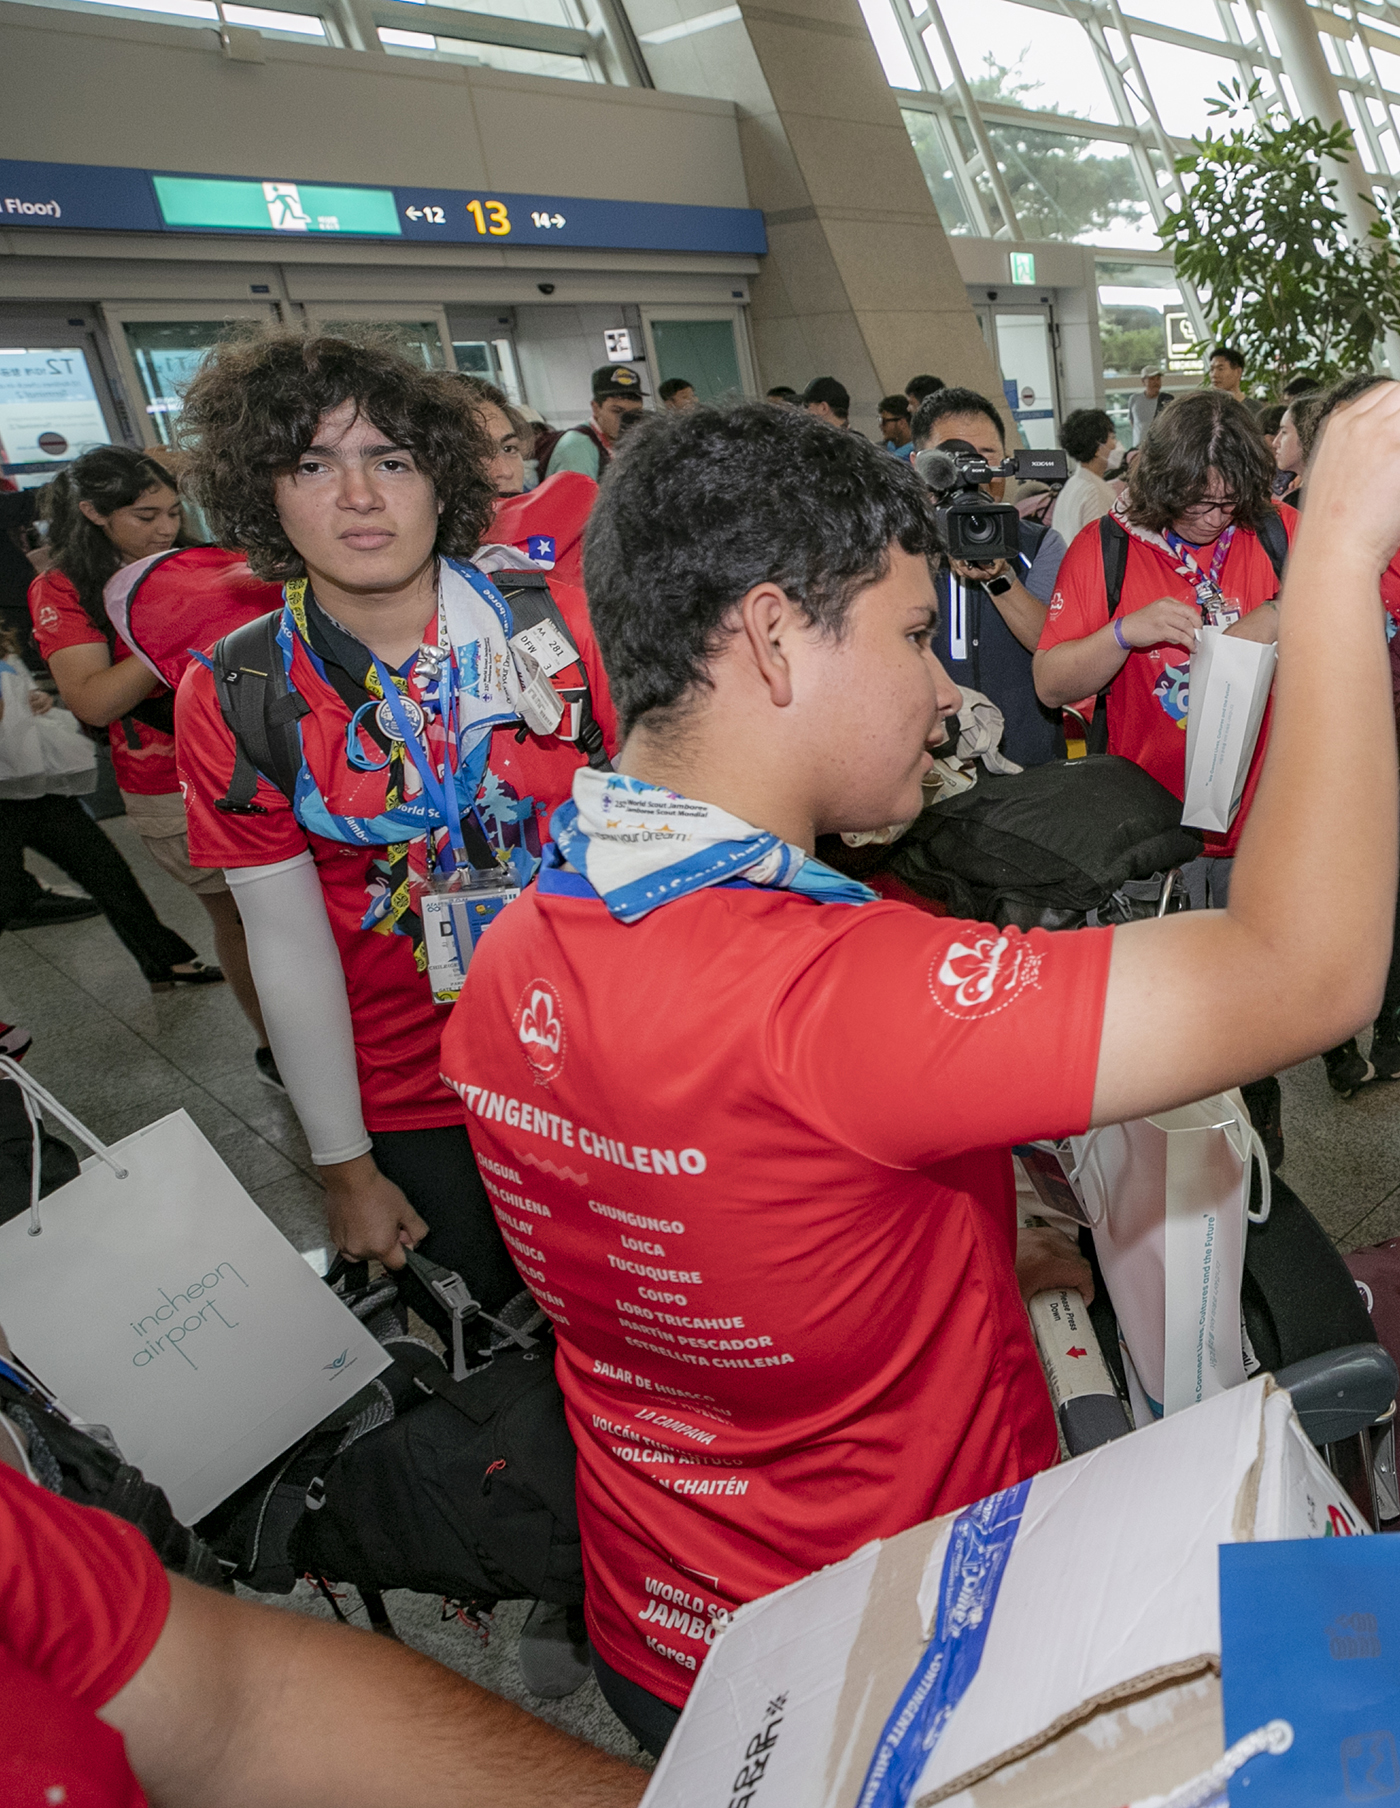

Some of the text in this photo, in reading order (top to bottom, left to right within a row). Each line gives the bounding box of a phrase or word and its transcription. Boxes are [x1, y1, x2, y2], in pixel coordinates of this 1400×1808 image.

[5, 199, 61, 218] Floor)
[422, 206, 446, 224] 12
[466, 199, 512, 236] 13
[531, 212, 551, 229] 14
[520, 635, 552, 671] DFW 3
[536, 627, 546, 637] AA
[549, 641, 565, 657] 281
[578, 1127, 707, 1175] CHILENO
[477, 1152, 523, 1185] CHAGUAL
[500, 1188, 552, 1219] CHILENA
[588, 1200, 685, 1235] CHUNGUNGO
[620, 1234, 666, 1257] LOICA
[607, 1254, 703, 1284] TUCUQUERE
[1202, 1266, 1211, 1285] and
[129, 1261, 249, 1337] incheon
[637, 1286, 688, 1306] COIPO
[1050, 1302, 1062, 1322] Down
[1058, 1290, 1078, 1332] Please Press
[1198, 1285, 1209, 1325] Cultures
[615, 1299, 746, 1330] LORO TRICAHUE
[132, 1299, 240, 1372] airport
[618, 1317, 774, 1351] MARTÍN PESCADOR
[1197, 1325, 1206, 1350] Lives,
[624, 1336, 795, 1369] ESTRELLITA CHILENA
[592, 1359, 633, 1384] SALAR
[635, 1375, 653, 1391] DE
[1195, 1350, 1204, 1395] Connect
[592, 1414, 640, 1442] VOLCÁN
[634, 1408, 657, 1421] LA
[651, 1414, 718, 1445] CAMPANA
[673, 1475, 749, 1496] CHAITÉN
[645, 1576, 704, 1613] WORLD
[638, 1599, 717, 1646] JAMBO
[646, 1635, 697, 1671] Korea
